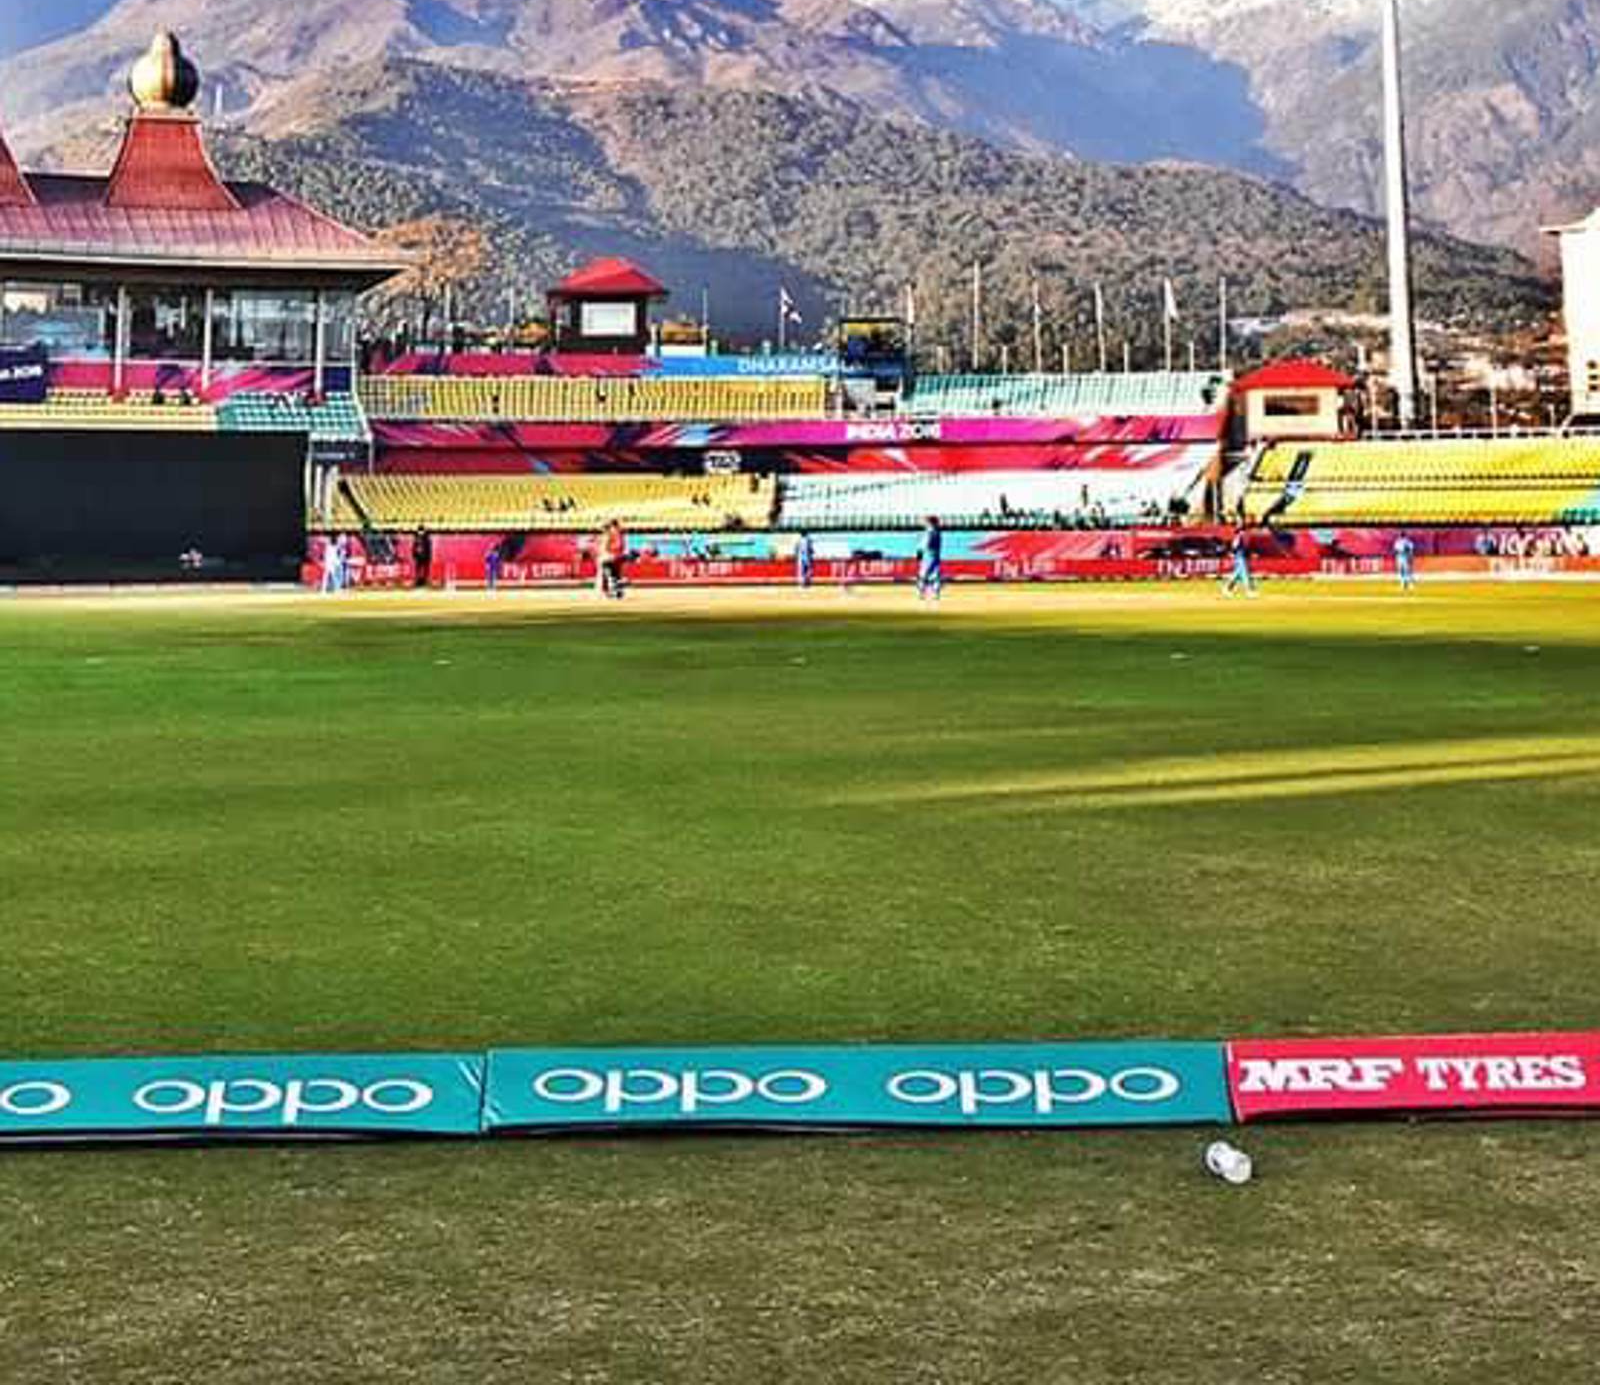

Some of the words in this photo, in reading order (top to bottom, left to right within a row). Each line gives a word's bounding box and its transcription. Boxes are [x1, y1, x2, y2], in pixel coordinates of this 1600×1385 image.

[533, 1068, 826, 1112] oppo
[888, 1067, 1179, 1113] oppo
[1239, 1058, 1403, 1092] MRF
[1416, 1055, 1586, 1090] TYRES
[134, 1079, 433, 1123] oppo
